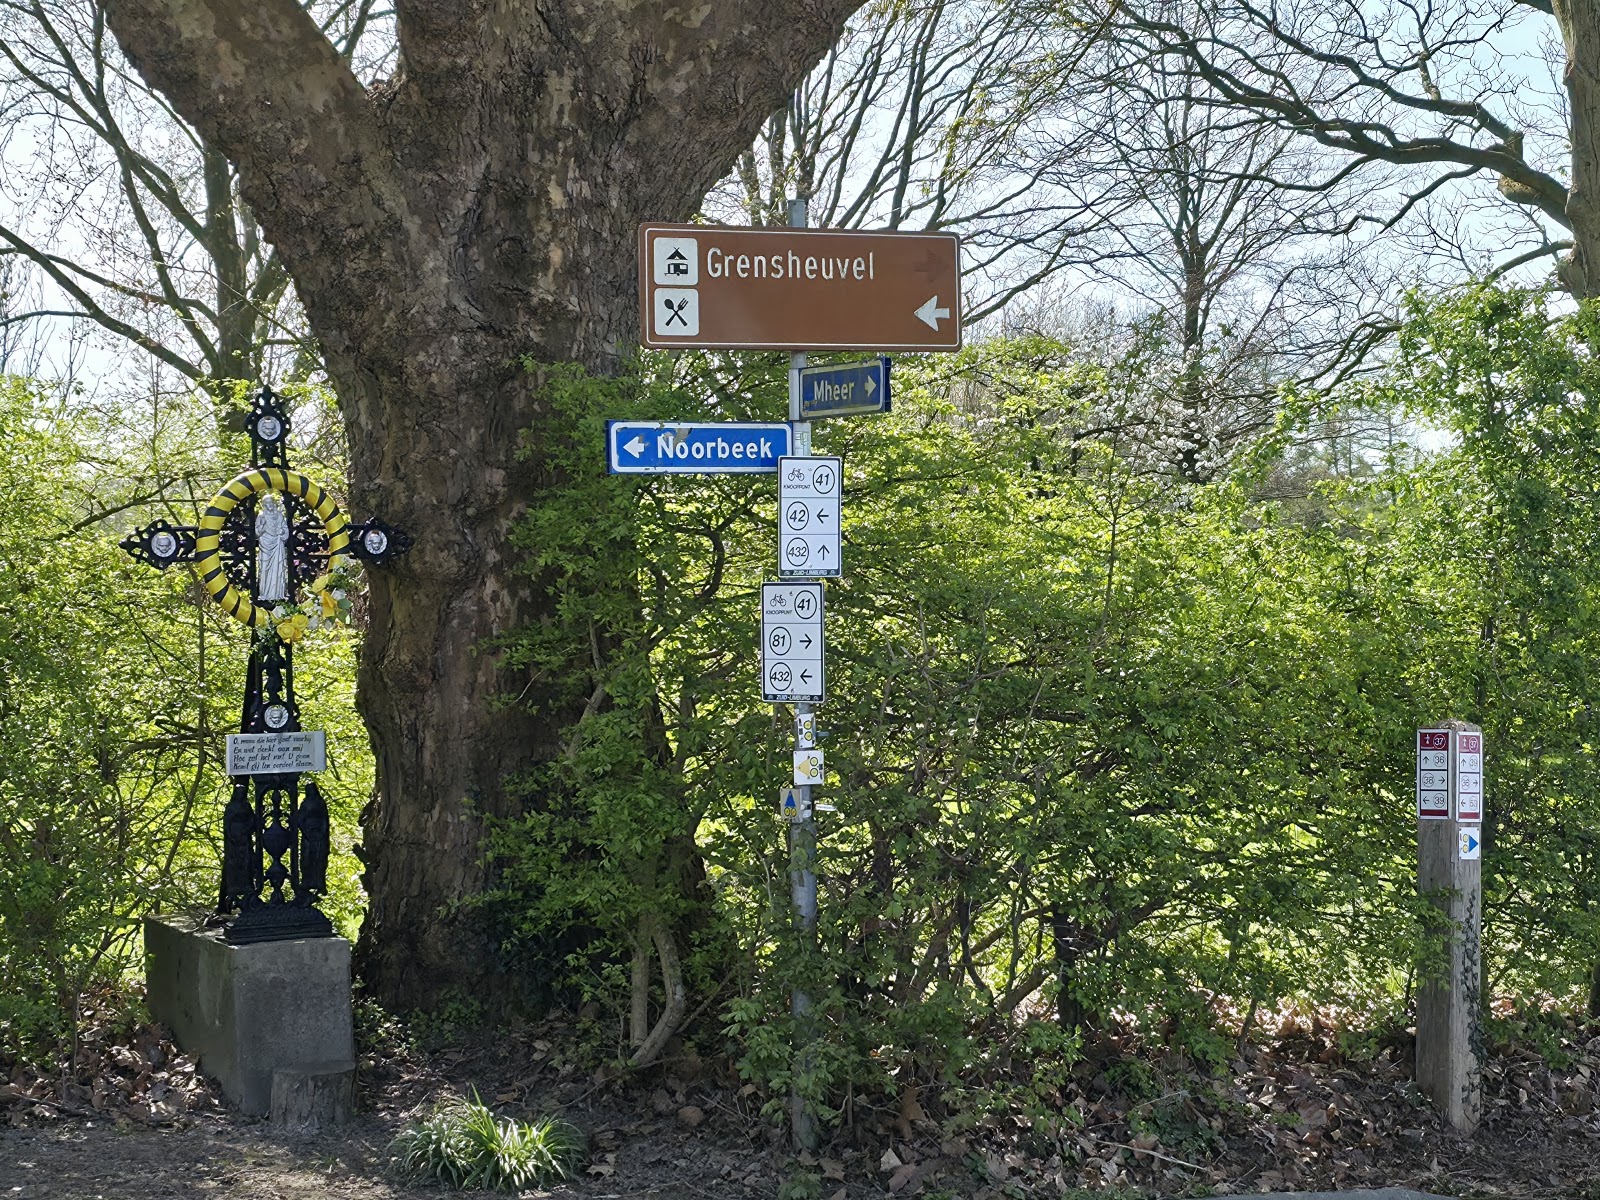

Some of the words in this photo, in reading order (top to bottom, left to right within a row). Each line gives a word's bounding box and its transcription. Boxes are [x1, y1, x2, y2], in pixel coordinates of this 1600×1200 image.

[706, 246, 874, 280] Grensheuvel
[814, 380, 854, 402] Mheer
[657, 436, 772, 459] Noorbeek
[816, 473, 830, 486] 41
[790, 510, 806, 522] 42
[788, 546, 807, 558] 432
[797, 598, 810, 610] 41
[772, 634, 786, 647] 81
[771, 671, 790, 682] 432
[1434, 738, 1444, 746] 37
[1434, 756, 1444, 764] 36
[1434, 796, 1445, 805] 39
